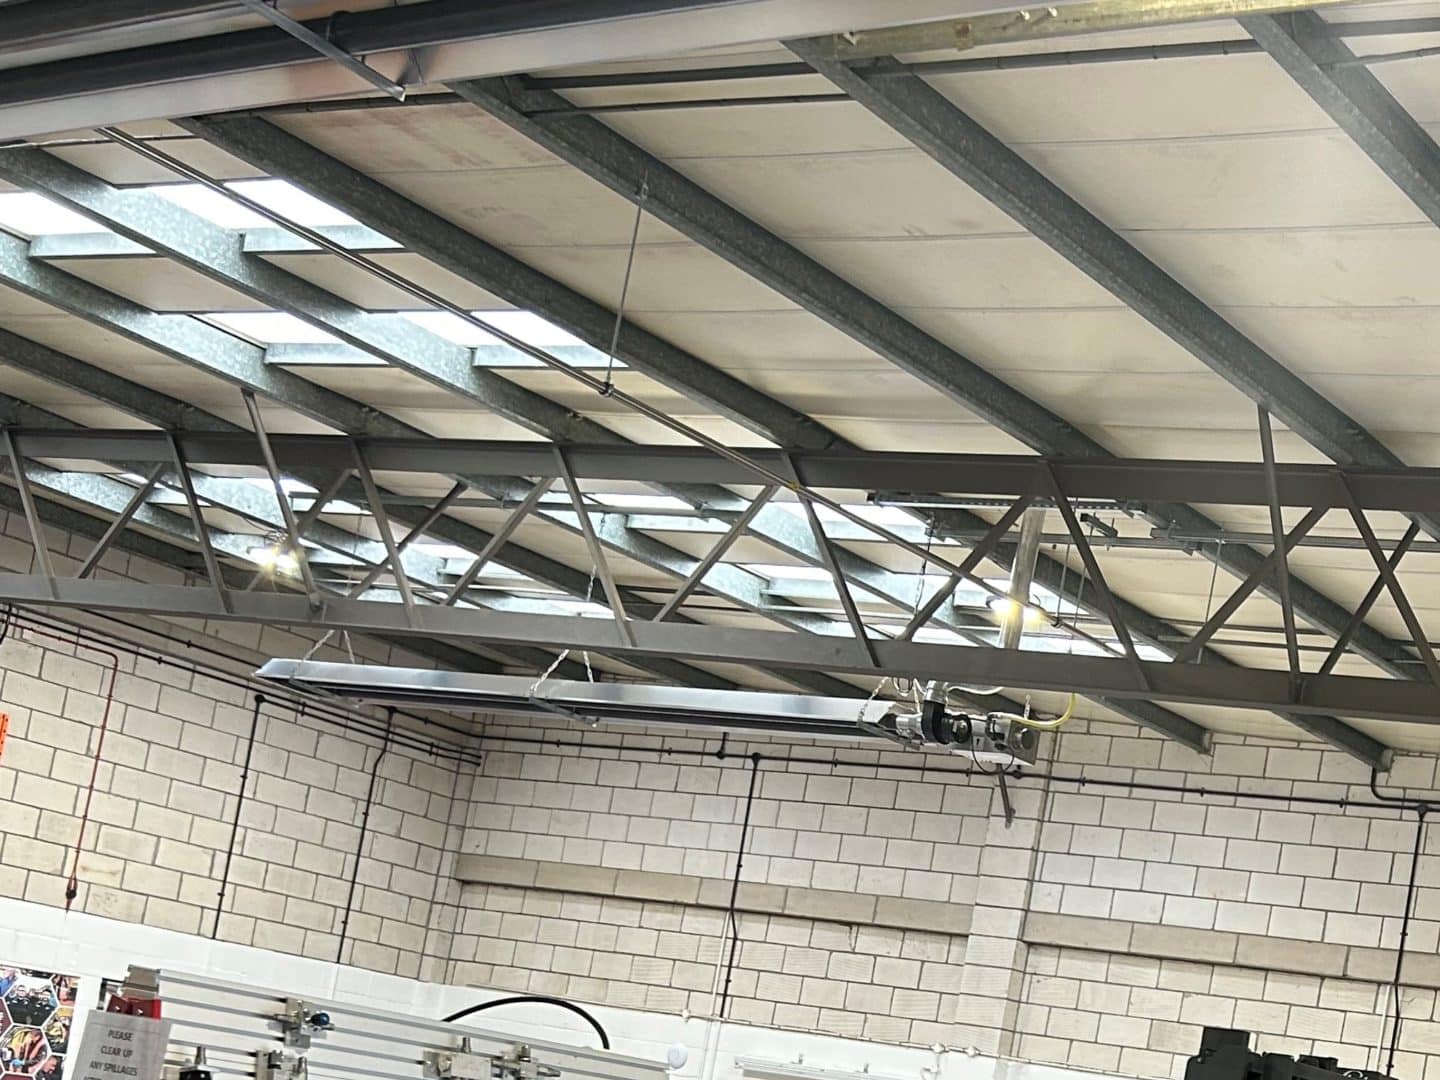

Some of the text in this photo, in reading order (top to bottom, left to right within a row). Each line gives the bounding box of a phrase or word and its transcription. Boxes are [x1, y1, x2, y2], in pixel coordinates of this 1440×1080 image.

[107, 1029, 133, 1042] PLEASE
[100, 1045, 133, 1058] CLEAR UP
[89, 1061, 138, 1076] ANY SPILLAGES
